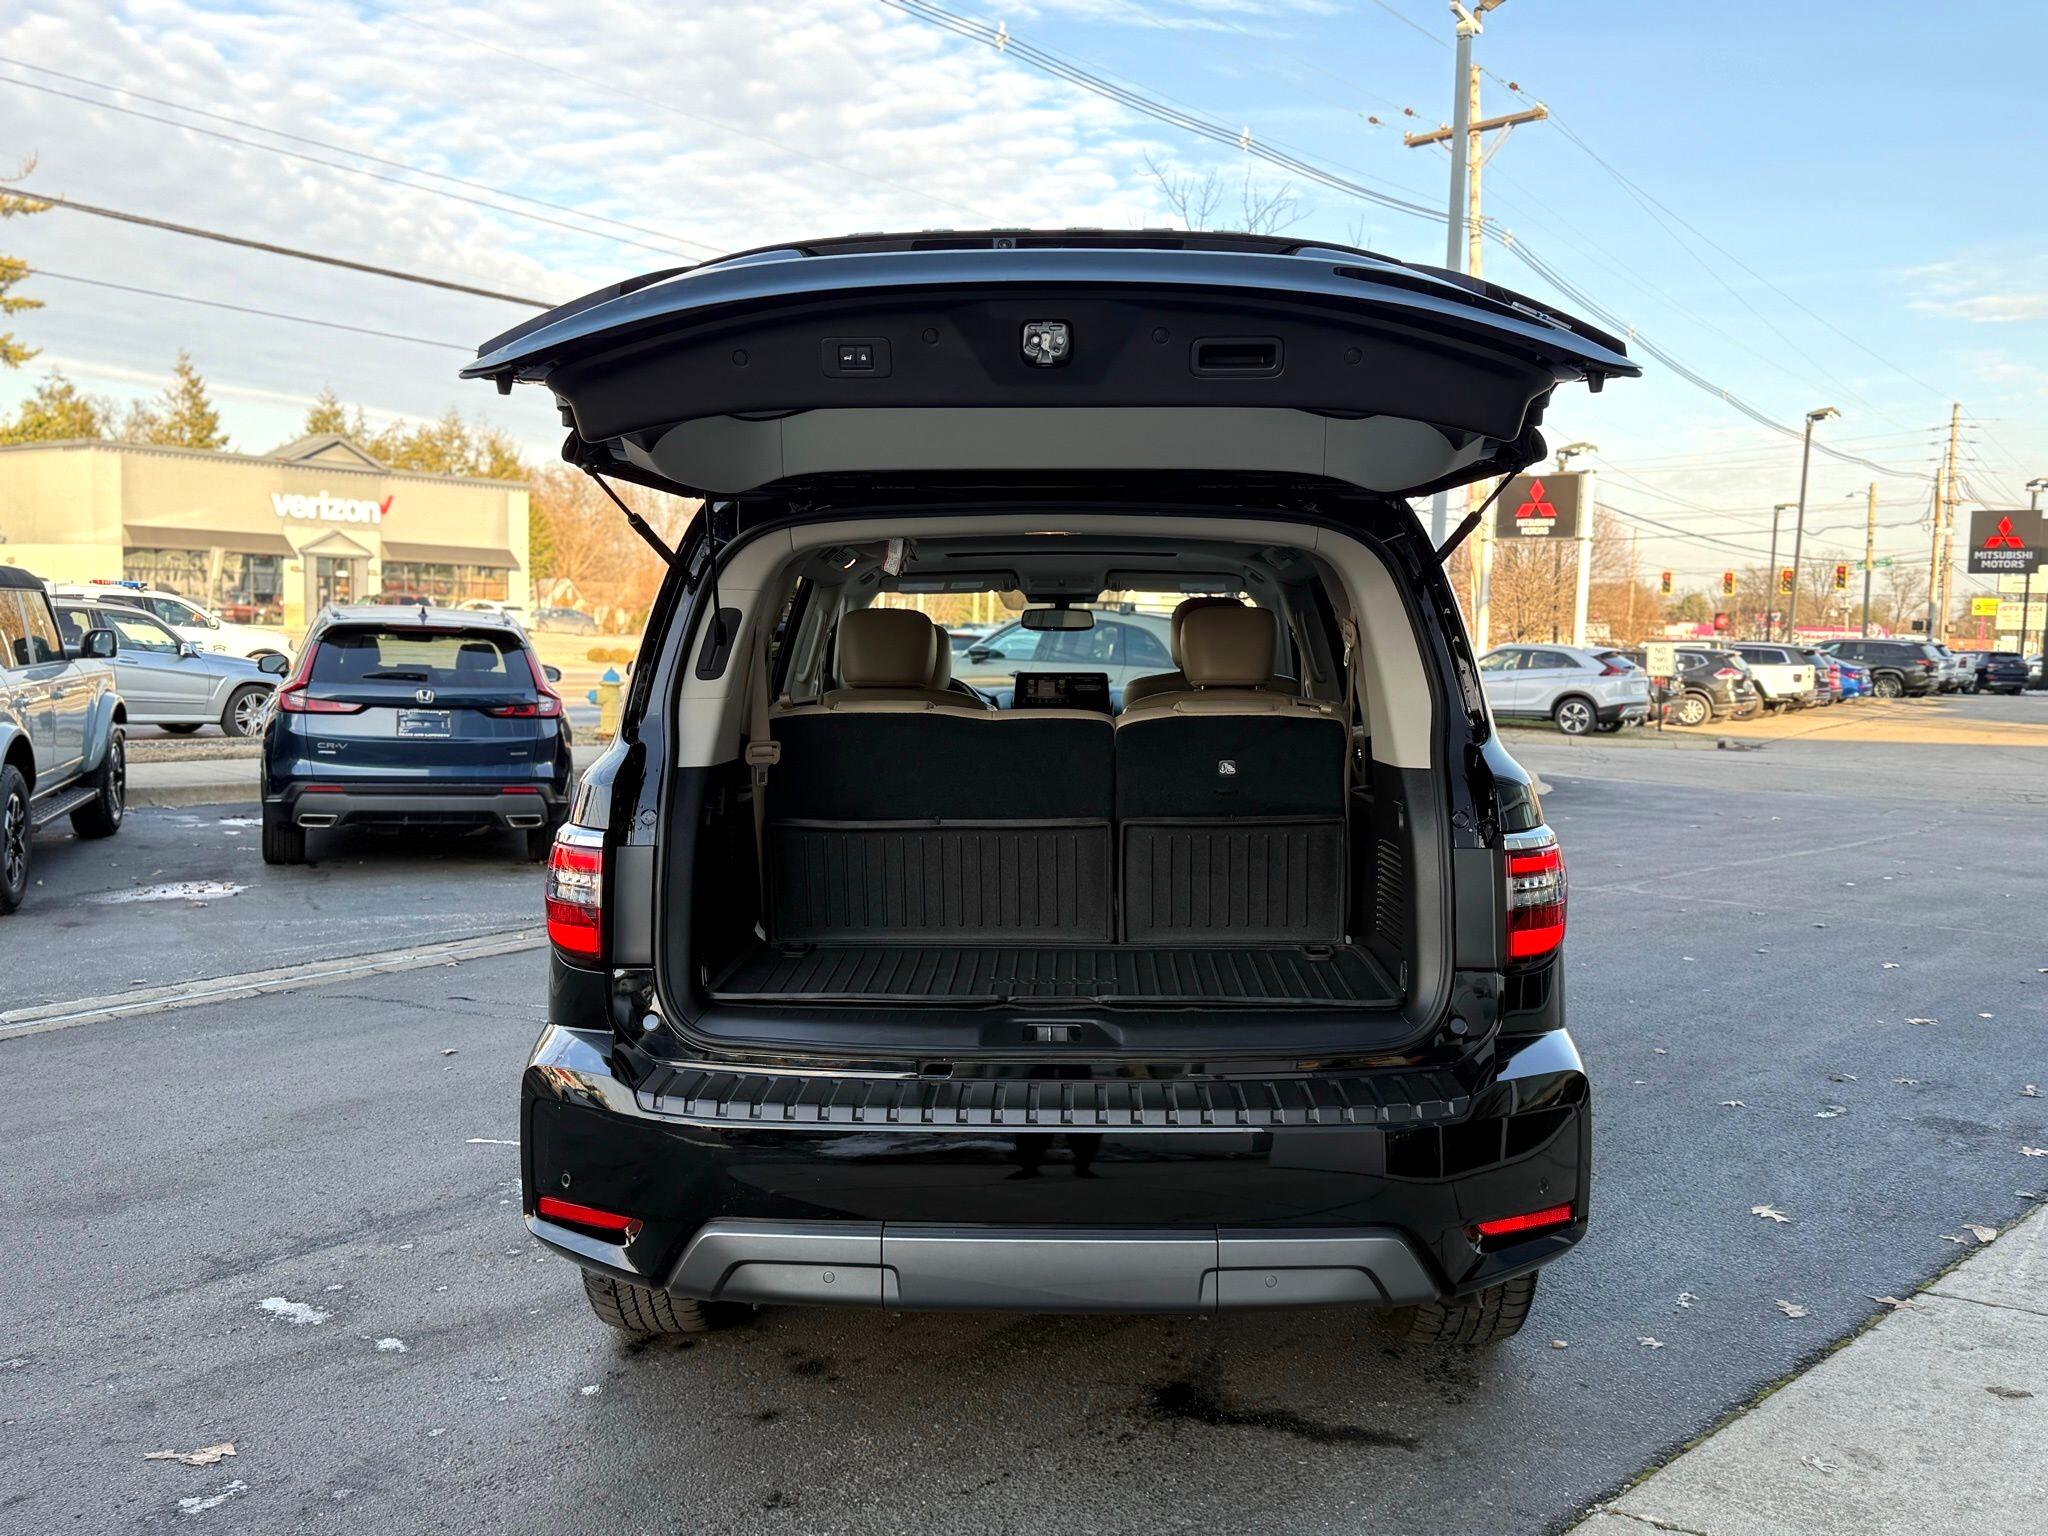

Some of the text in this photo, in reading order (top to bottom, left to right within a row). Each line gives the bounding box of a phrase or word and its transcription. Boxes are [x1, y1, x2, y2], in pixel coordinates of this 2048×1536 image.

[271, 490, 381, 524] verizon
[1974, 550, 2034, 560] MITSUBISHI
[1981, 560, 2025, 568] MOTORS
[1654, 647, 1667, 656] NO
